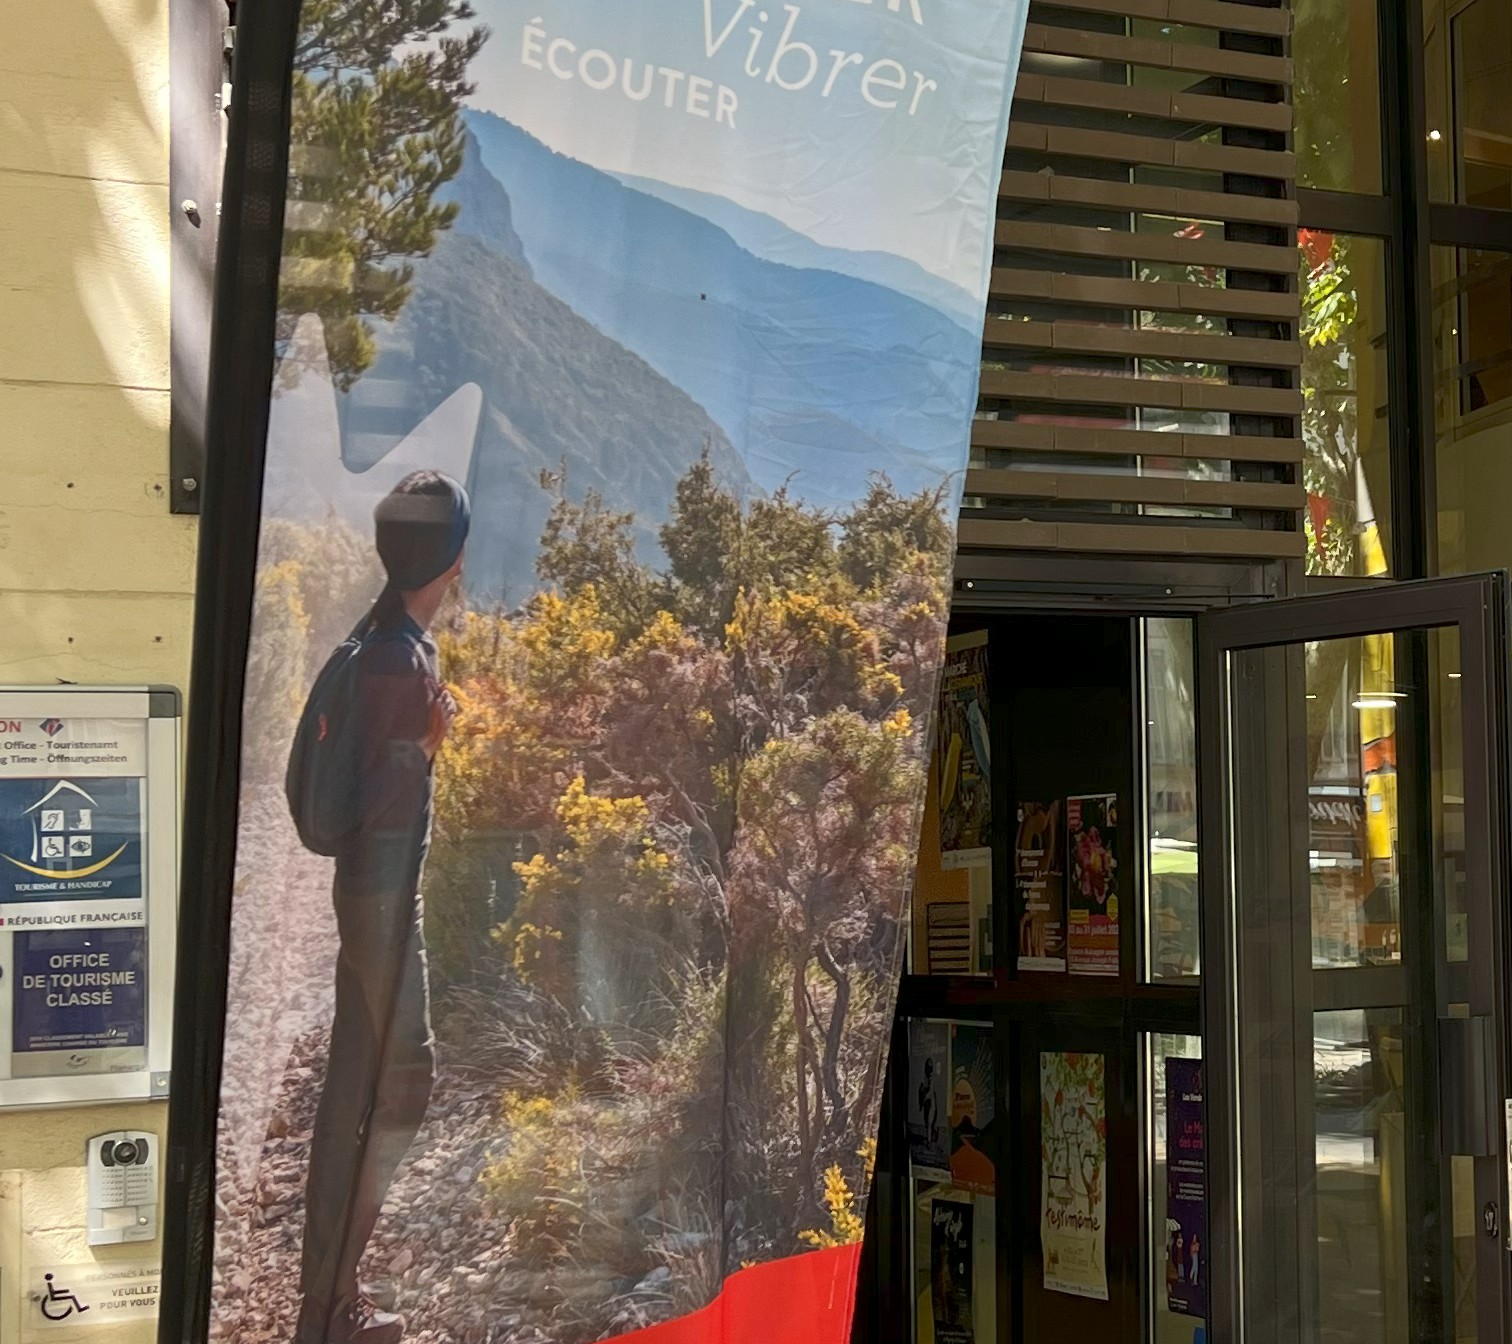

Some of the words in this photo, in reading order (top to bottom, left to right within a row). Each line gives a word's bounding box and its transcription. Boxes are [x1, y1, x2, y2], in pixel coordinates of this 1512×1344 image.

[521, 16, 739, 130] ÉCOUTER
[46, 740, 119, 750] Touristenamt
[7, 914, 77, 926] RÉPUBLIQUE
[80, 911, 143, 924] FRANÇAISE
[49, 953, 110, 969] OFFICE
[23, 974, 46, 989] DE
[51, 971, 136, 987] TOURISME
[46, 990, 113, 1007] CLASSÉ
[112, 1285, 158, 1297] VEUILLEZ
[100, 1300, 127, 1310] POUR
[129, 1298, 155, 1307] VOUS
